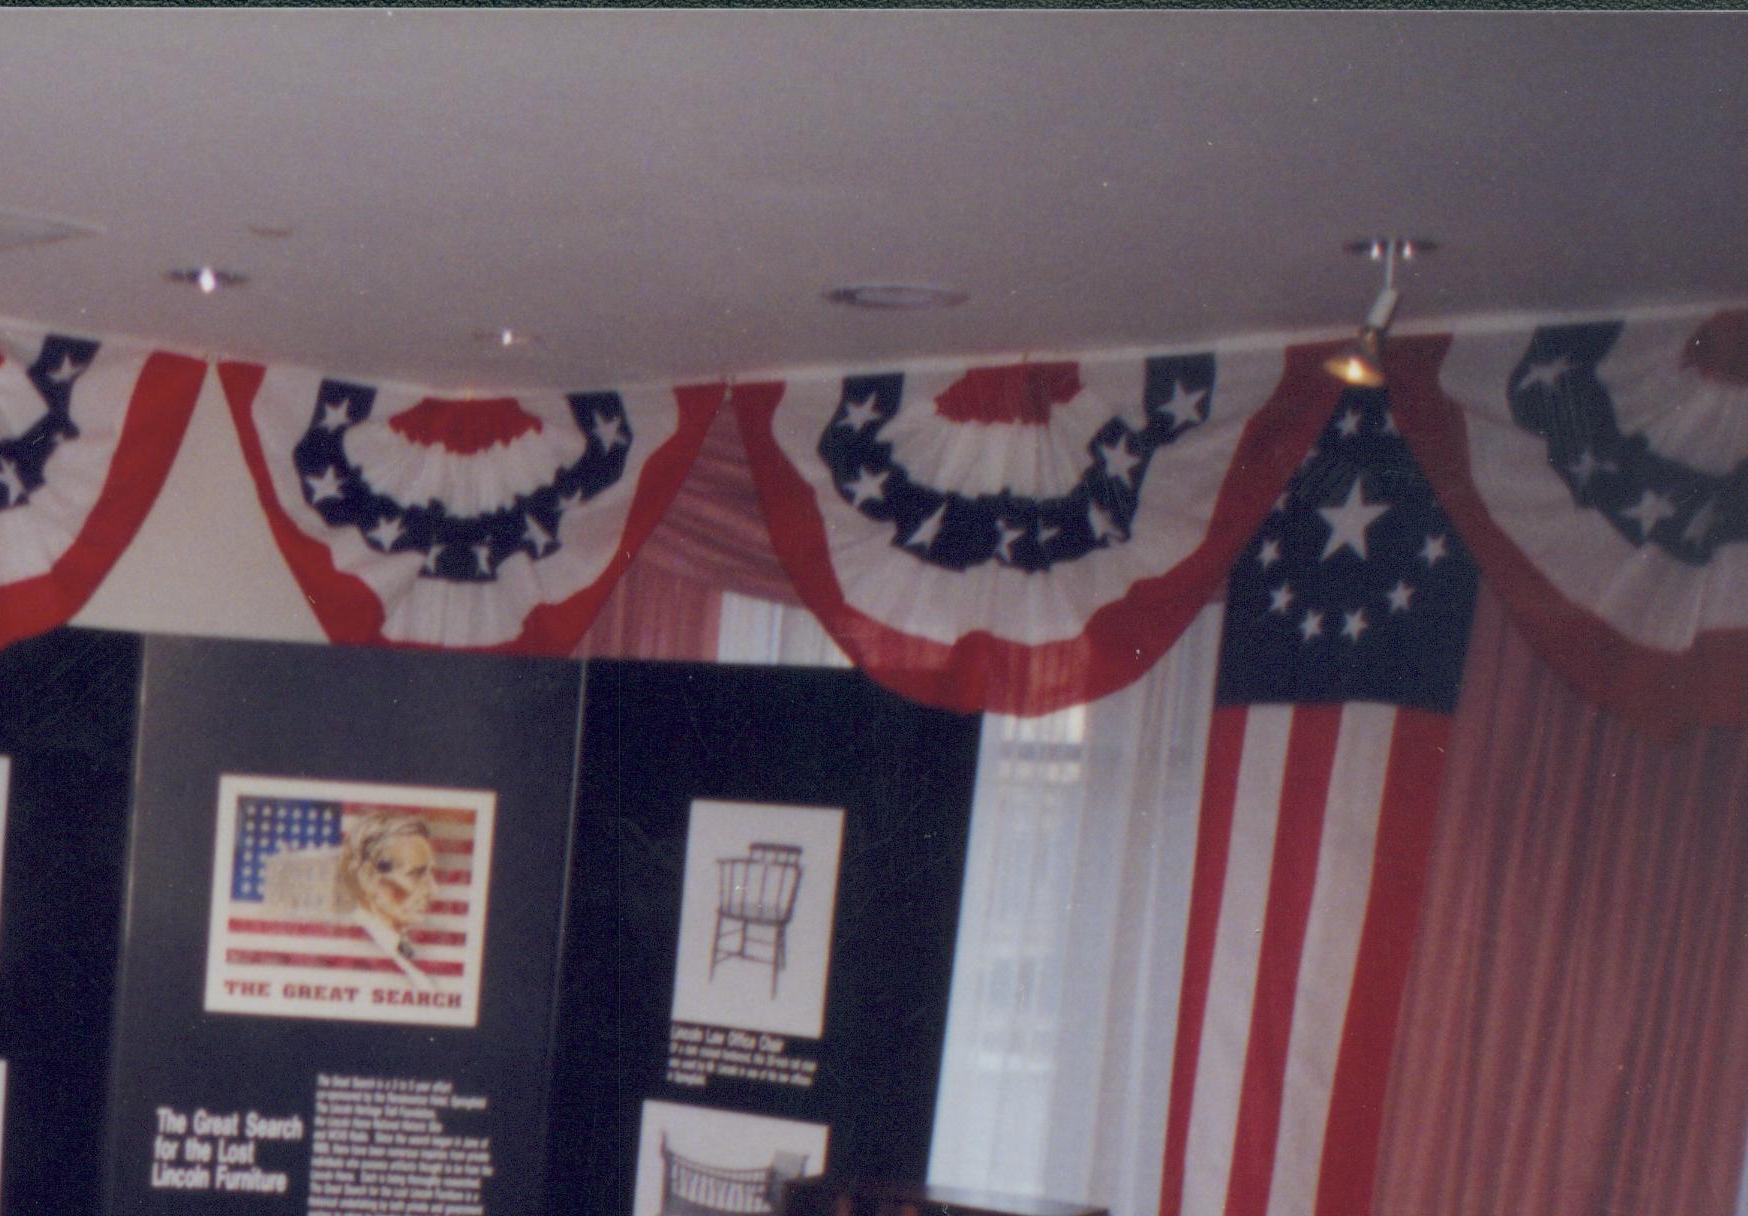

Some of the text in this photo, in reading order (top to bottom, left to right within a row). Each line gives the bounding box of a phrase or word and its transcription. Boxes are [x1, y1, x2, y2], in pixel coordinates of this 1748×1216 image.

[223, 980, 462, 1008] THE GREAT SEARCH
[156, 1107, 304, 1140] The Great Search
[154, 1136, 256, 1164] for the Lost
[151, 1162, 289, 1193] Lincoln Furniture
